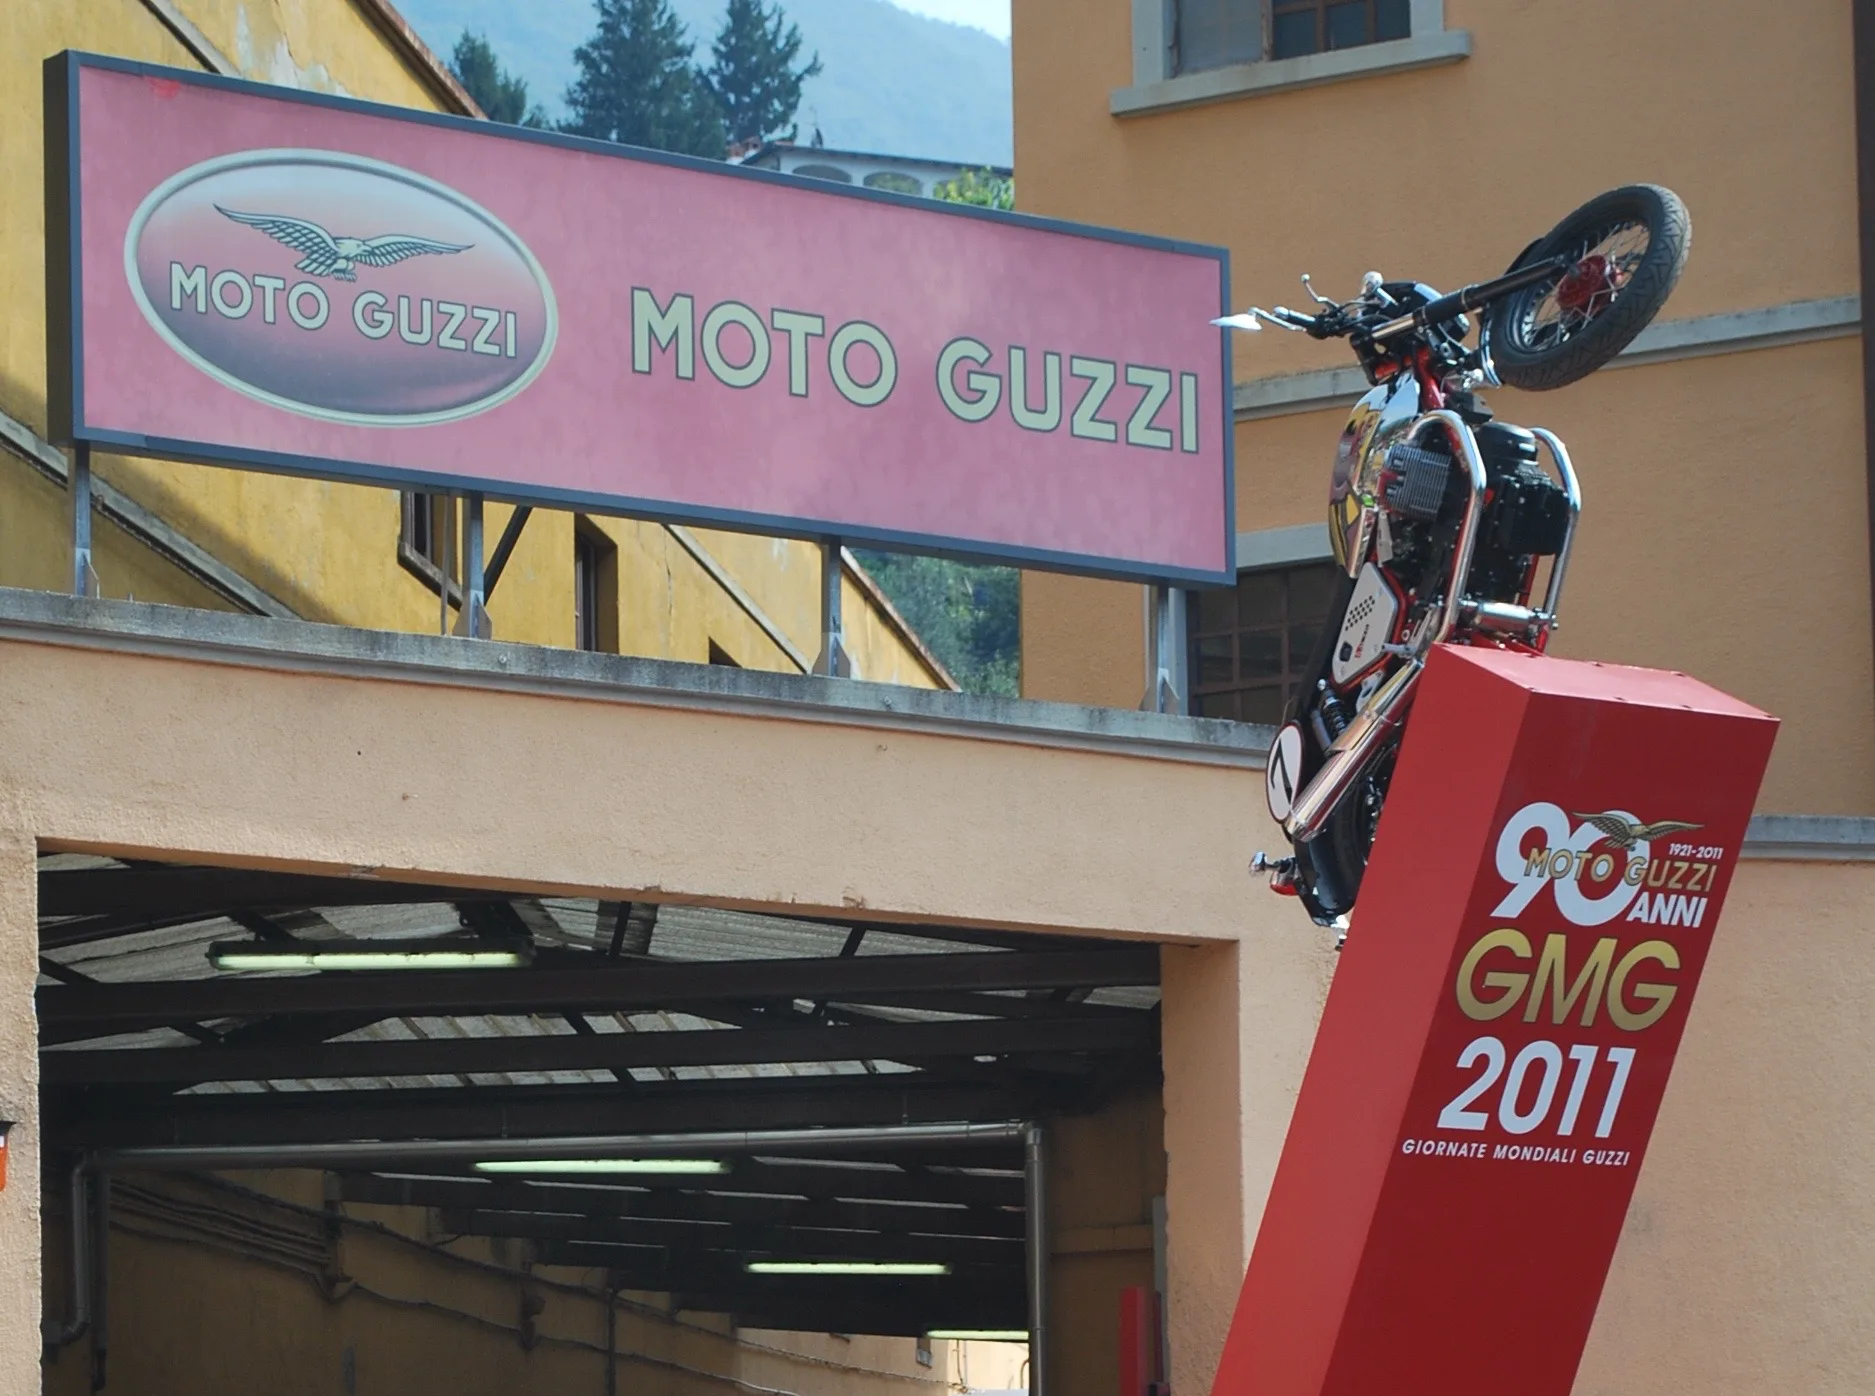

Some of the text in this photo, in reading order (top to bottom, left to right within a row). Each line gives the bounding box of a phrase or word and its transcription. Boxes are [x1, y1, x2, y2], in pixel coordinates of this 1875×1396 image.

[169, 260, 518, 359] MOTO GUZZI
[630, 286, 1200, 454] MOTO GUZZI
[1489, 801, 1651, 927] 90
[1523, 847, 1718, 893] MOTO GUZZI
[1668, 842, 1725, 861] 1921-2011
[1625, 891, 1709, 929] ANNI
[1456, 928, 1681, 1032] GMG
[1436, 1035, 1637, 1139] 2011
[1401, 1138, 1631, 1167] GIORNATE MONDIALI GUZZI
